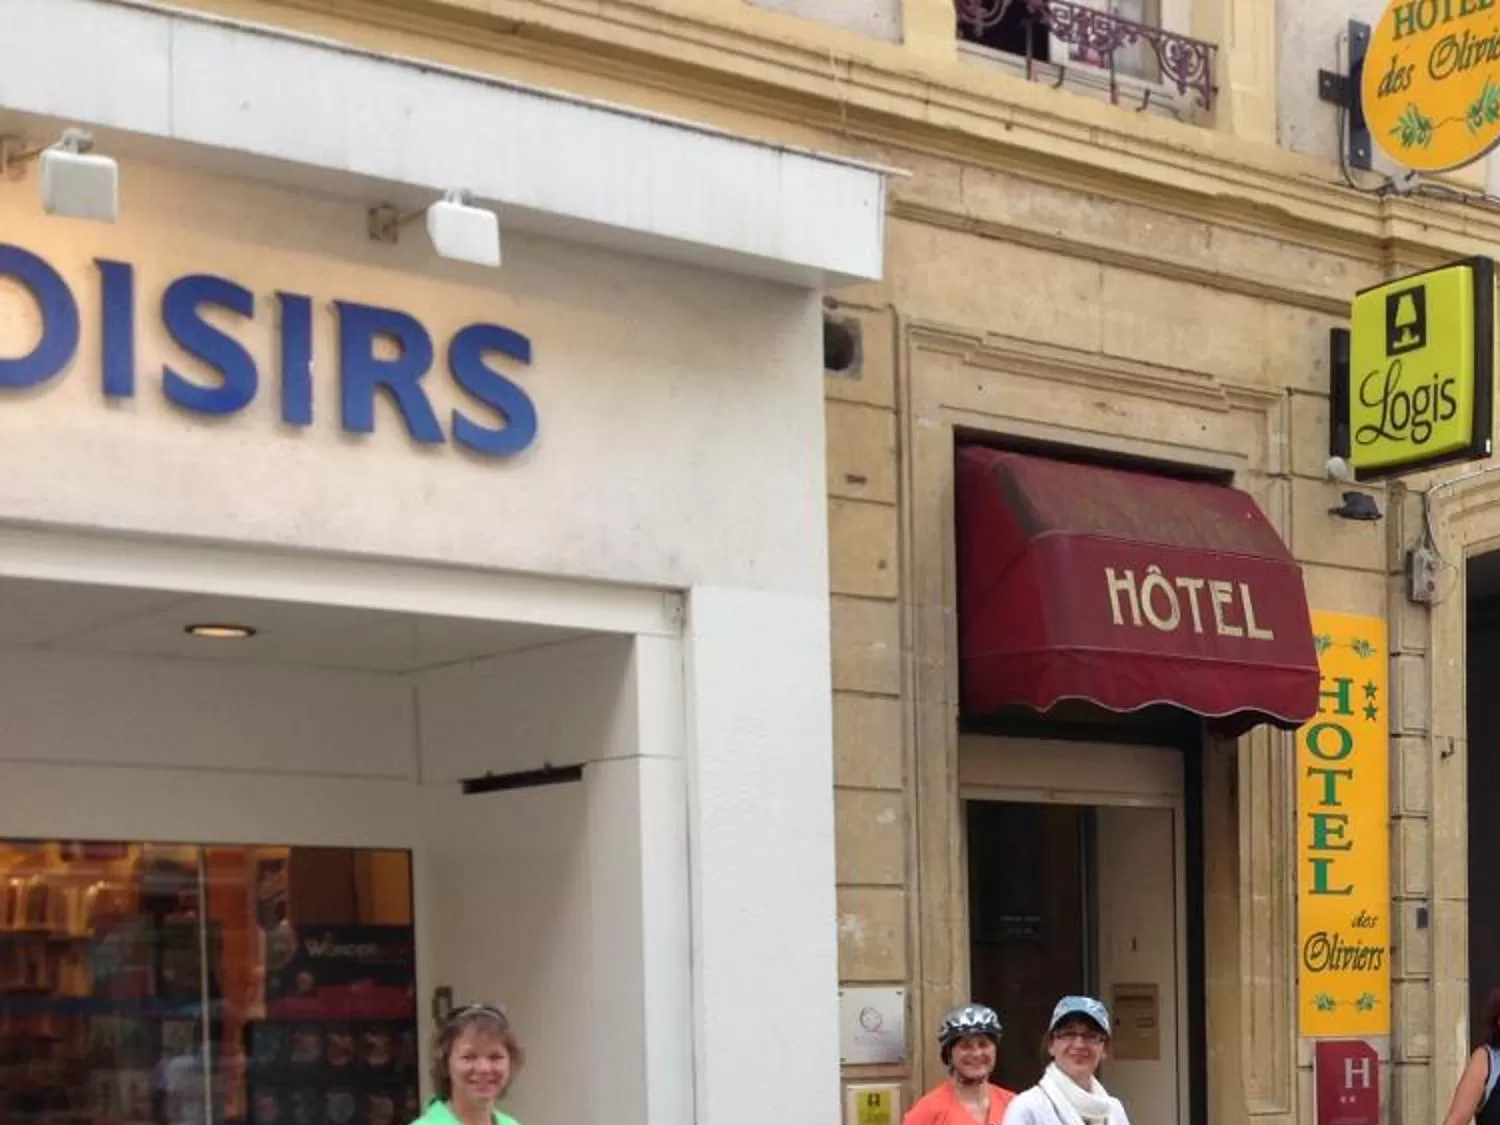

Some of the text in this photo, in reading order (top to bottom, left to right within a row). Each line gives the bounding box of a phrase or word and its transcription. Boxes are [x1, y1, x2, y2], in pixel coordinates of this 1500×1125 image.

[1377, 53, 1415, 98] des
[1354, 359, 1457, 445] Logis
[1104, 564, 1275, 641] HÔTEL
[1305, 676, 1355, 896] HOTEL
[1351, 910, 1377, 929] des
[1303, 931, 1385, 973] Oliviers
[1344, 1057, 1371, 1089] H
